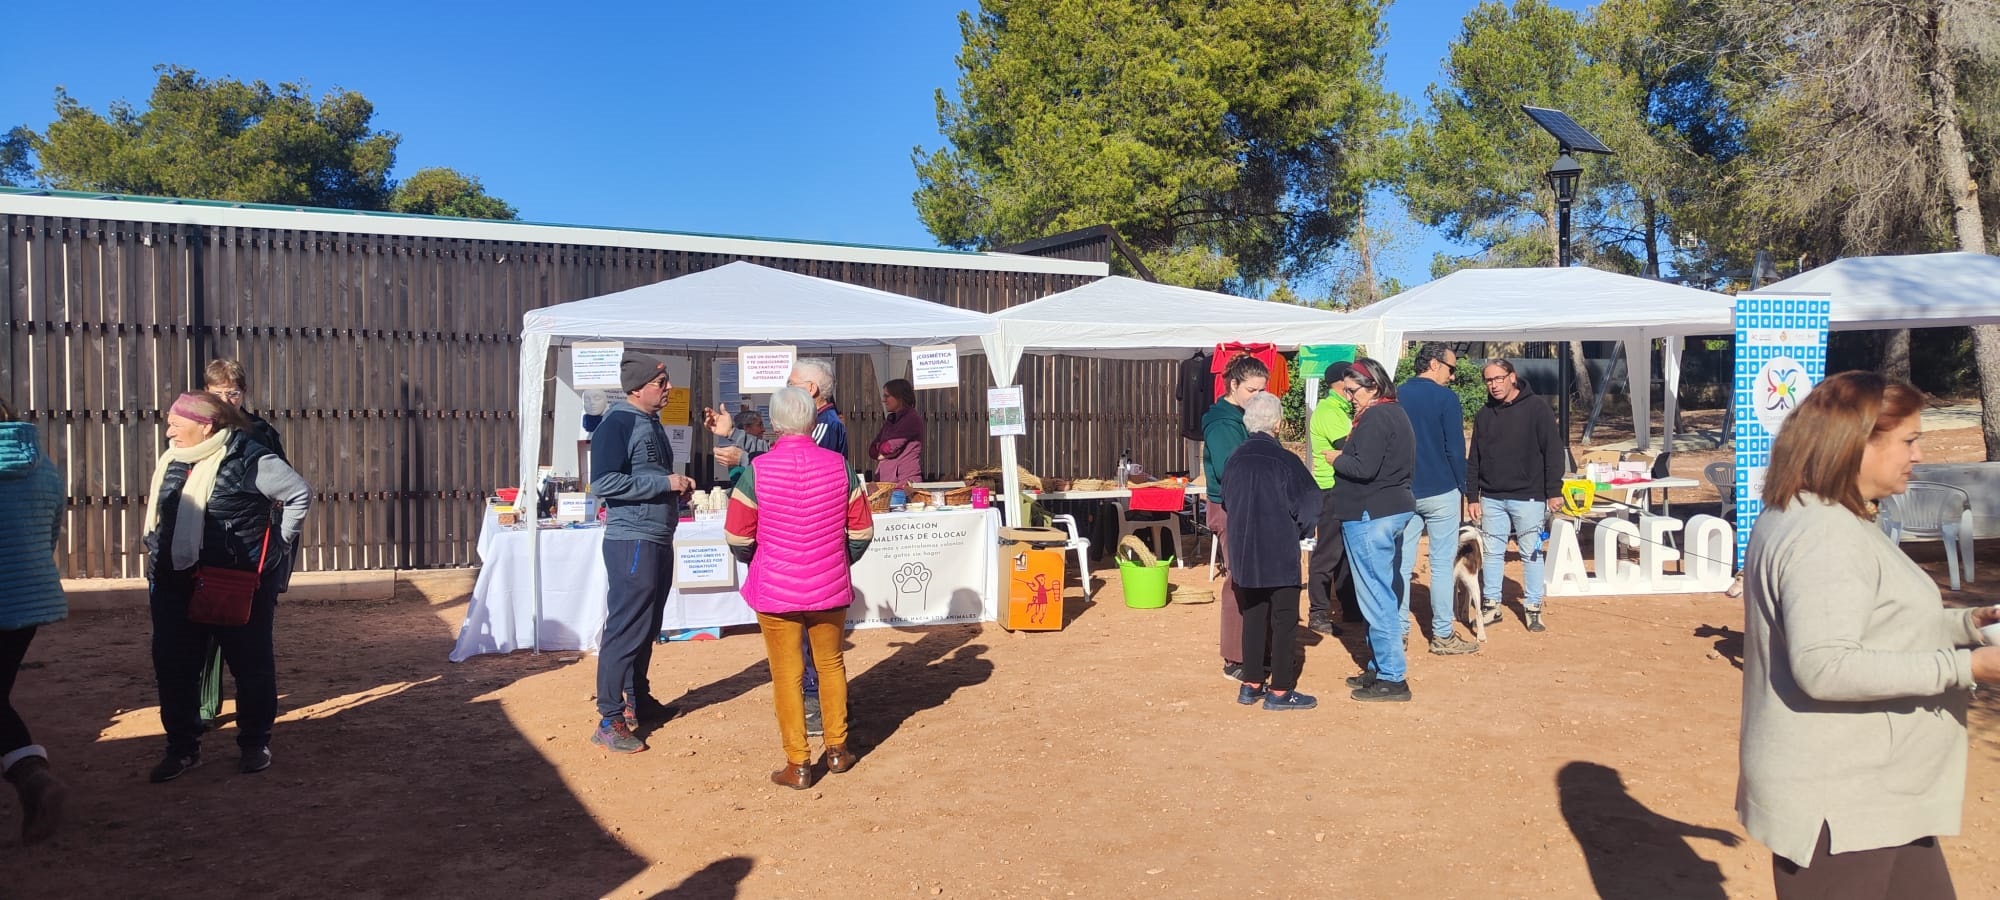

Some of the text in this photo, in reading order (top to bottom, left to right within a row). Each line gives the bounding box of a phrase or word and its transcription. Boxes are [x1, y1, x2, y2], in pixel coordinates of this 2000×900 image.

[885, 522, 938, 532] ASOCIACIÓN
[873, 530, 967, 543] MALISTAS DE OLOCAU
[1545, 514, 1735, 592] ACEO
